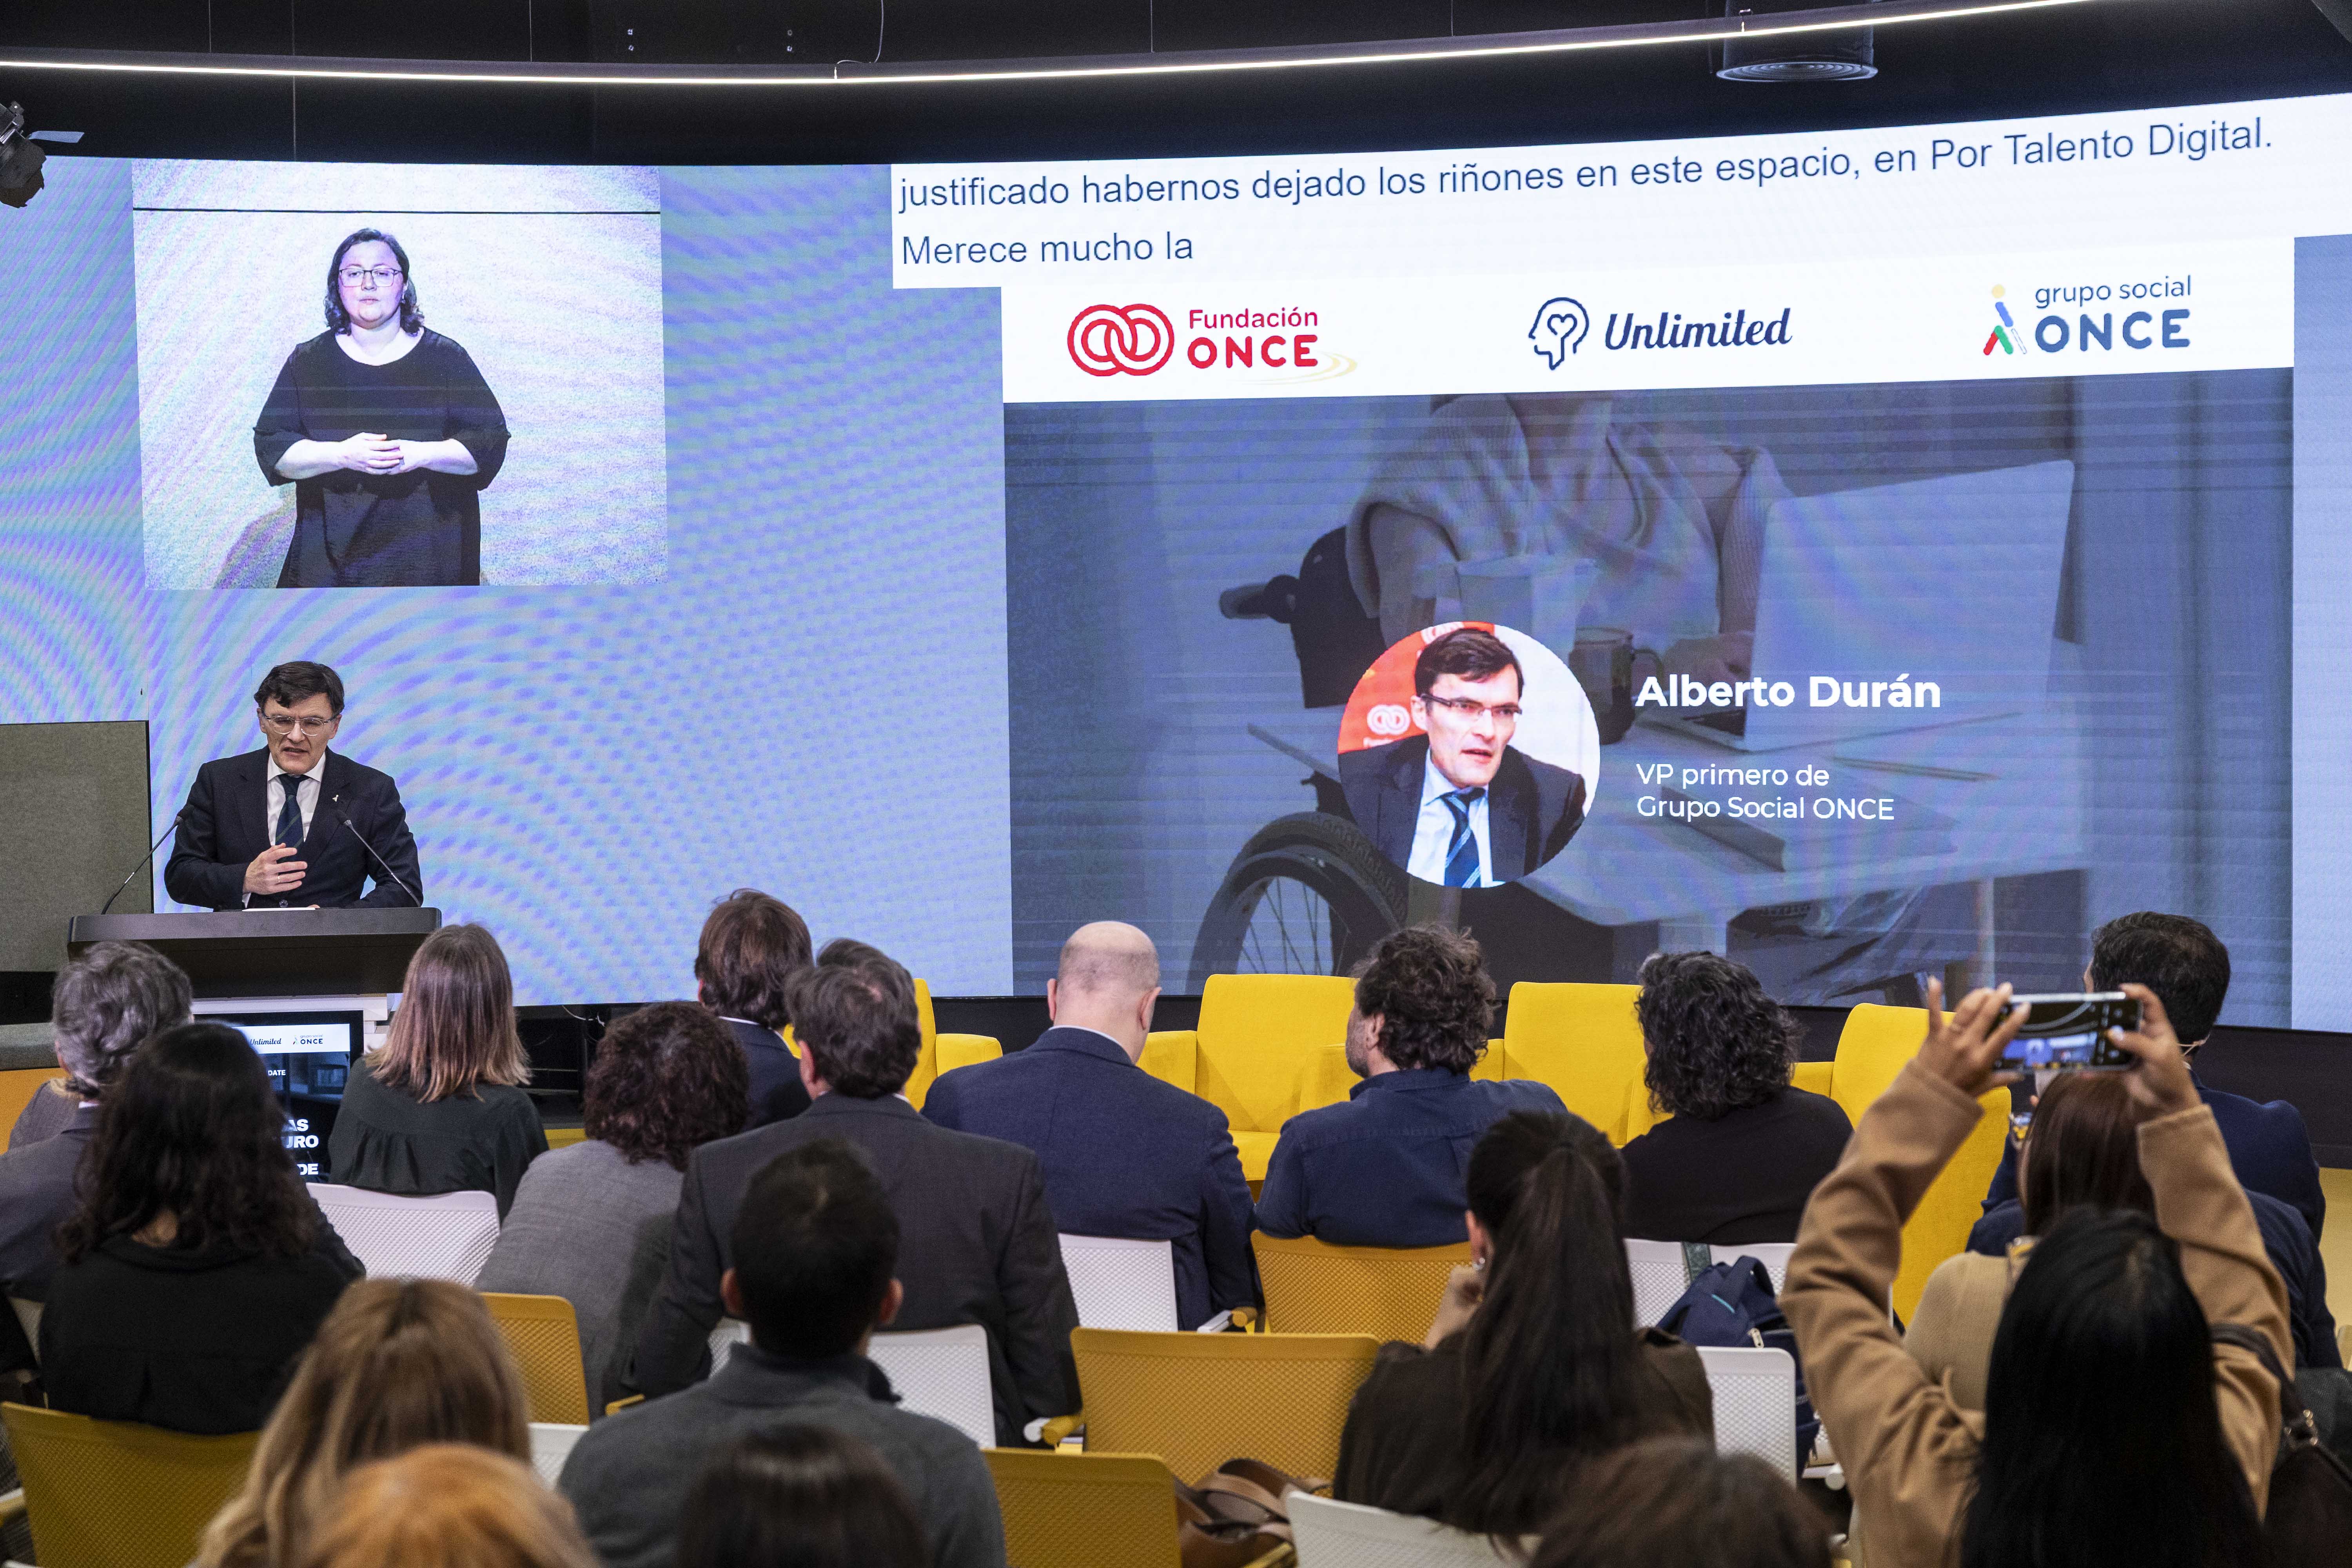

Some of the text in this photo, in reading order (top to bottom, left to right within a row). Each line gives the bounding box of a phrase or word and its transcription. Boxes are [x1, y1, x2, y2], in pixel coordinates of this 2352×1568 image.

[898, 116, 2271, 214] justificado habernos dejado los riñones en este espacio, en Por Talento Digital.
[903, 231, 1192, 265] Merece mucho la
[2035, 275, 2191, 309] grupo social
[1189, 307, 1318, 329] Fundación
[1605, 308, 1791, 350] Unlimited
[2034, 309, 2190, 353] ONCE
[1187, 334, 1318, 369] ONCE
[1636, 673, 1940, 707] Alberto Durán
[1637, 764, 1829, 789] VP primero de
[1637, 796, 1894, 822] Grupo Social ONCE
